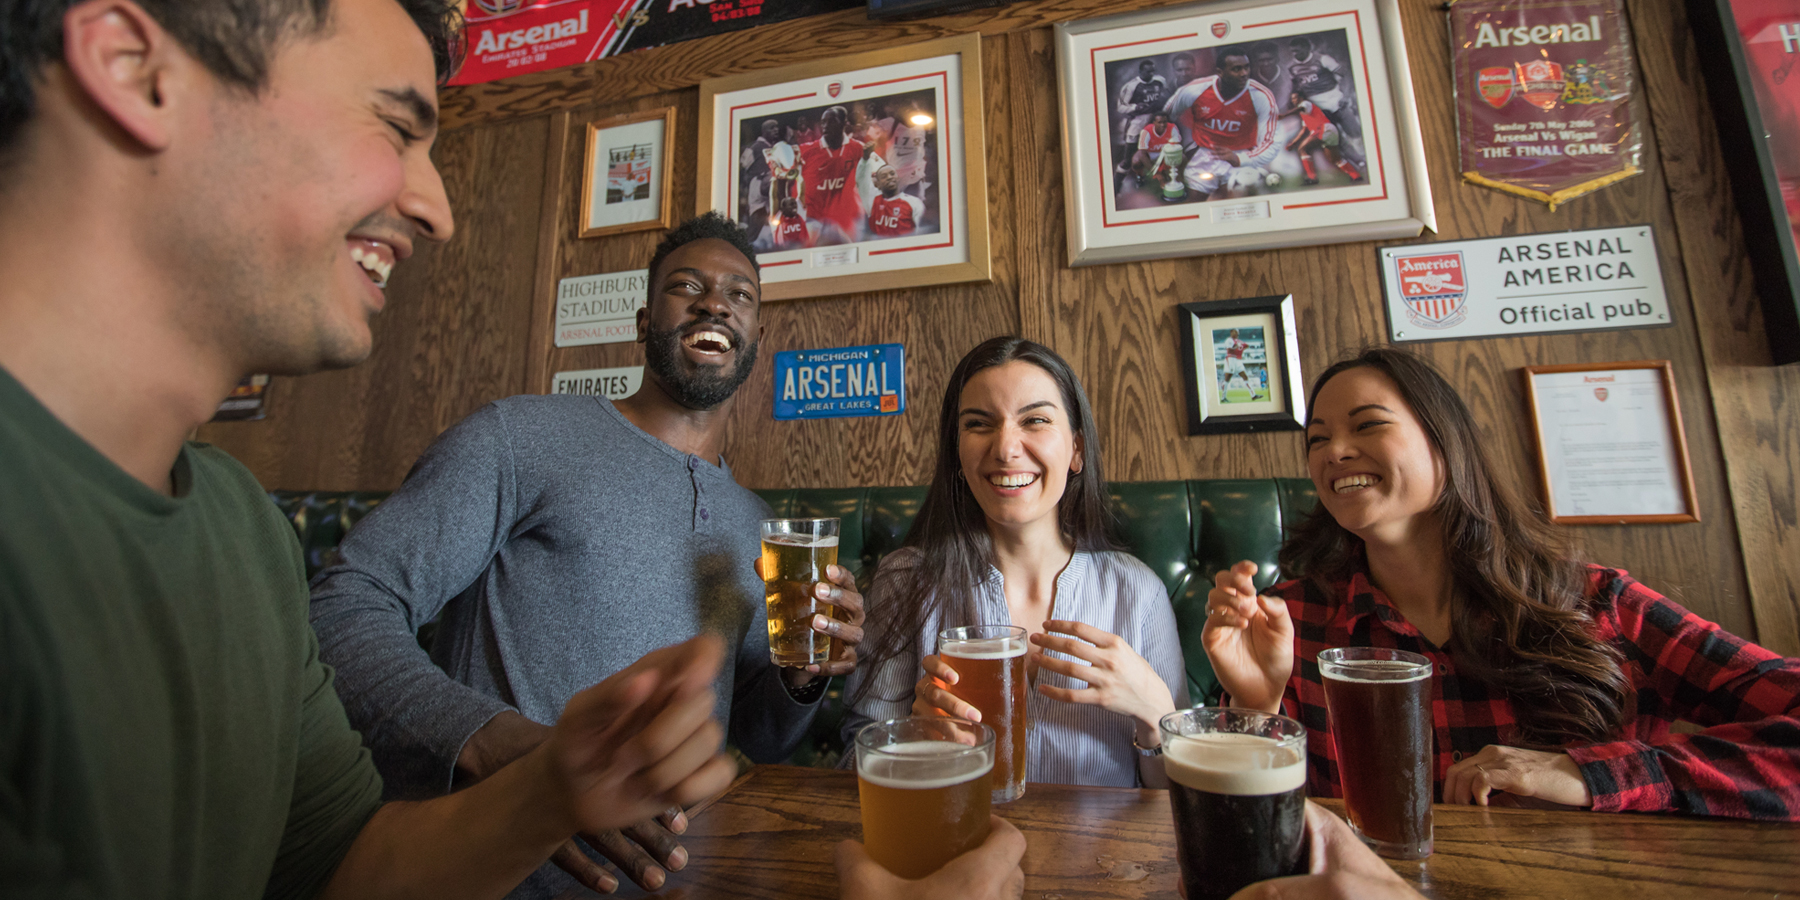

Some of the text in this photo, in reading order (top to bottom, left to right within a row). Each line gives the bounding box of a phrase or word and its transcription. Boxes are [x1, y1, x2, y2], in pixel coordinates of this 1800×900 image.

[474, 8, 589, 55] Arsenal
[1474, 15, 1602, 49] Arsenal
[1204, 119, 1241, 132] JVC
[1493, 120, 1596, 132] Sunday 7th May 2006
[1493, 130, 1598, 143] Arsenal Vs Wigan
[1482, 143, 1615, 158] THE FINAL GAME
[817, 177, 845, 190] JVC
[784, 223, 802, 234] JVC
[876, 215, 899, 228] JVC
[1498, 237, 1632, 264] ARSENAL
[1400, 258, 1459, 274] America
[1503, 261, 1635, 288] AMERICA
[562, 275, 648, 299] HIGHBURY
[560, 296, 635, 319] STADIUM
[1499, 299, 1652, 325] Official pub
[561, 328, 603, 340] ARSENAL
[808, 351, 868, 362] MICHIGAN
[558, 375, 628, 396] EMIRATES
[783, 361, 896, 401] ARSENAL
[804, 400, 871, 411] GREAT LAKES
